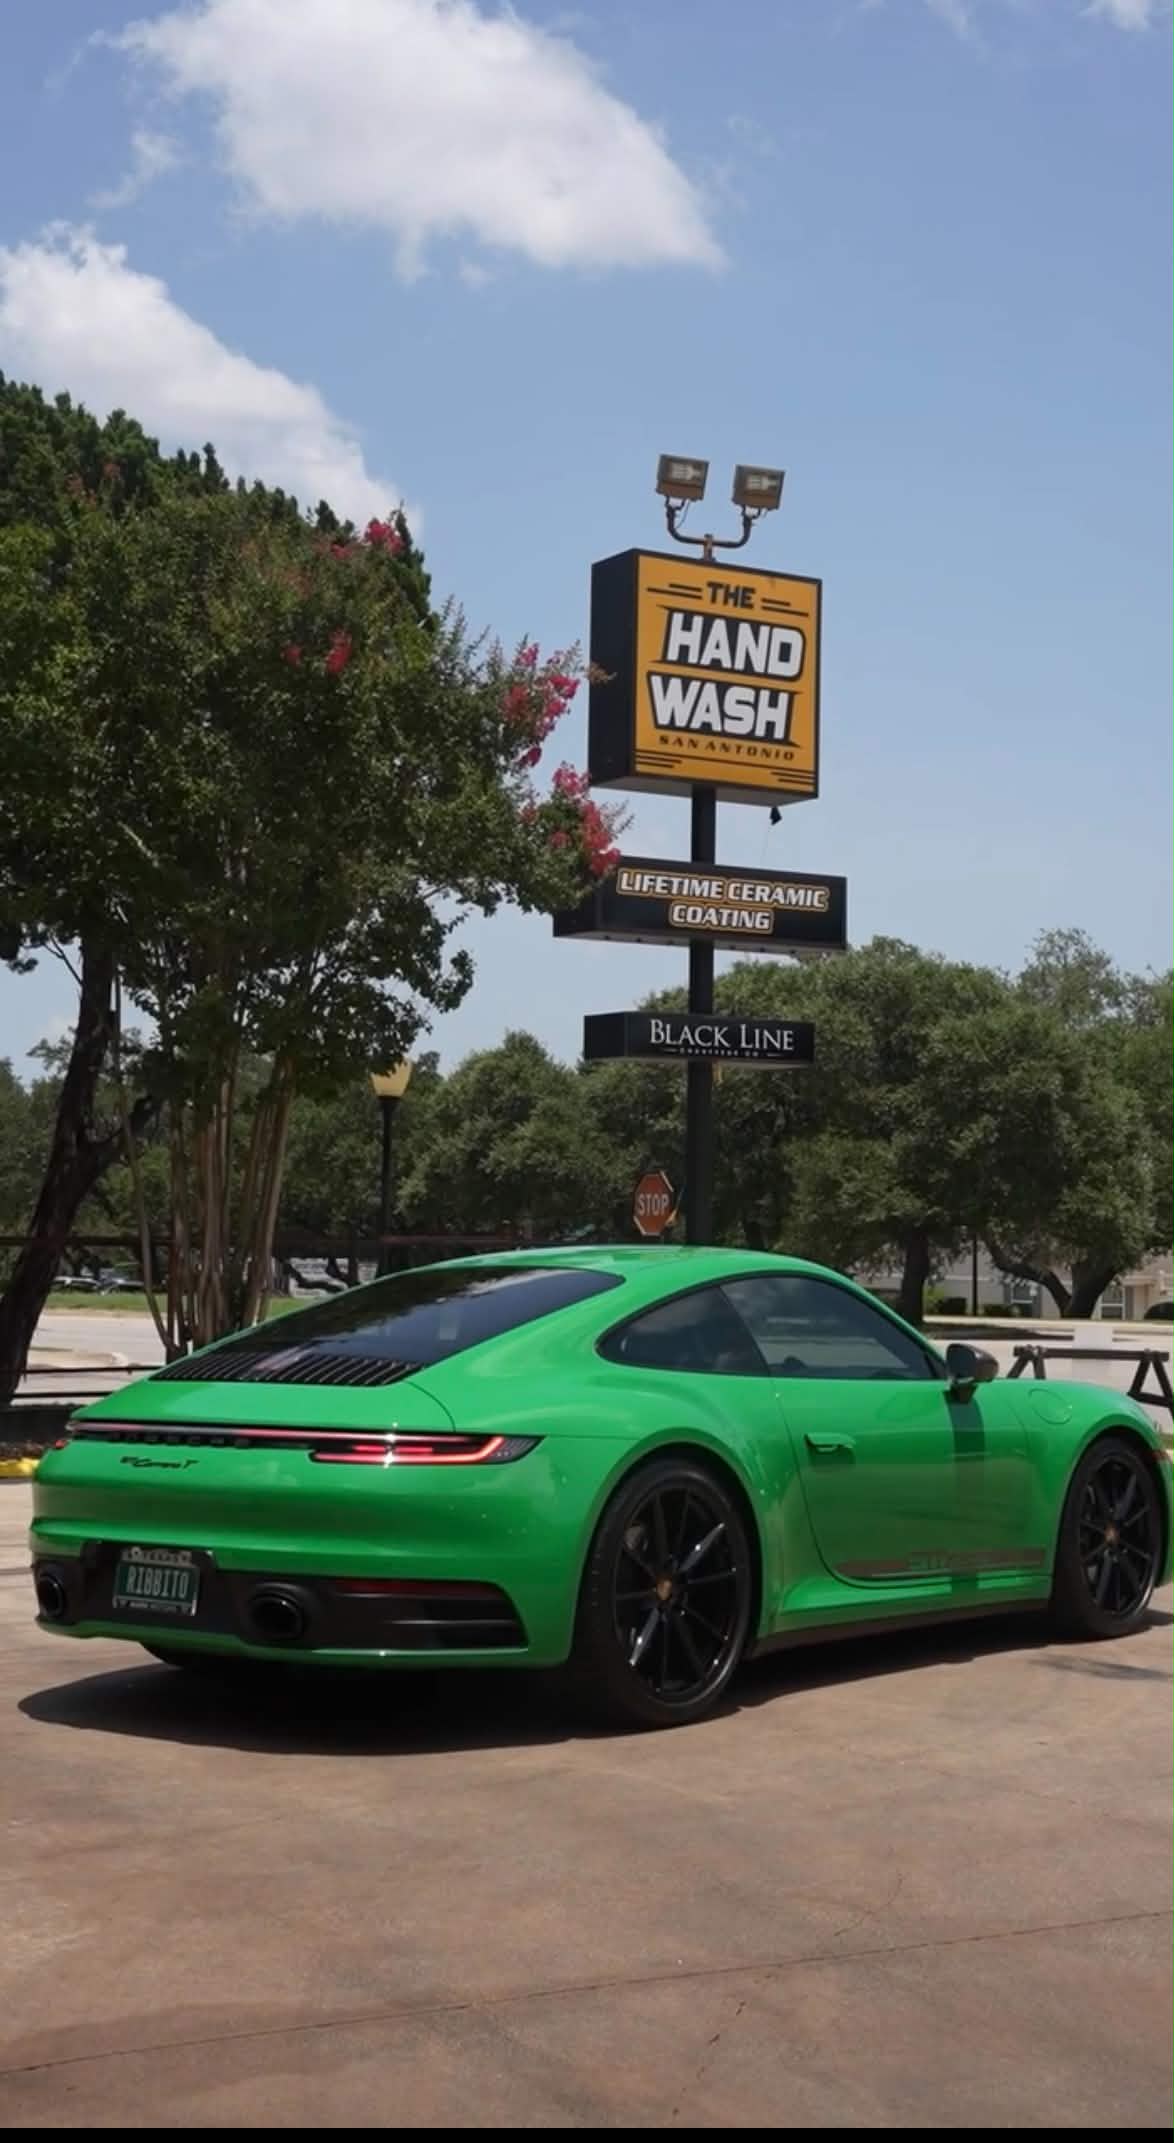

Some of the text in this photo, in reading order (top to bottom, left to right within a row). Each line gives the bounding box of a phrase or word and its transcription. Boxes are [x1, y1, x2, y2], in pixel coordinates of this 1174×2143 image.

[706, 581, 756, 609] THE
[666, 612, 804, 678] HAND
[650, 675, 789, 740] WASH
[659, 735, 795, 760] SAN ANTONIO
[620, 872, 826, 908] LIFETIME CERAMIC
[673, 904, 770, 929] COATING
[638, 1193, 670, 1217] STOP
[126, 1565, 190, 1600] RIBBITO
